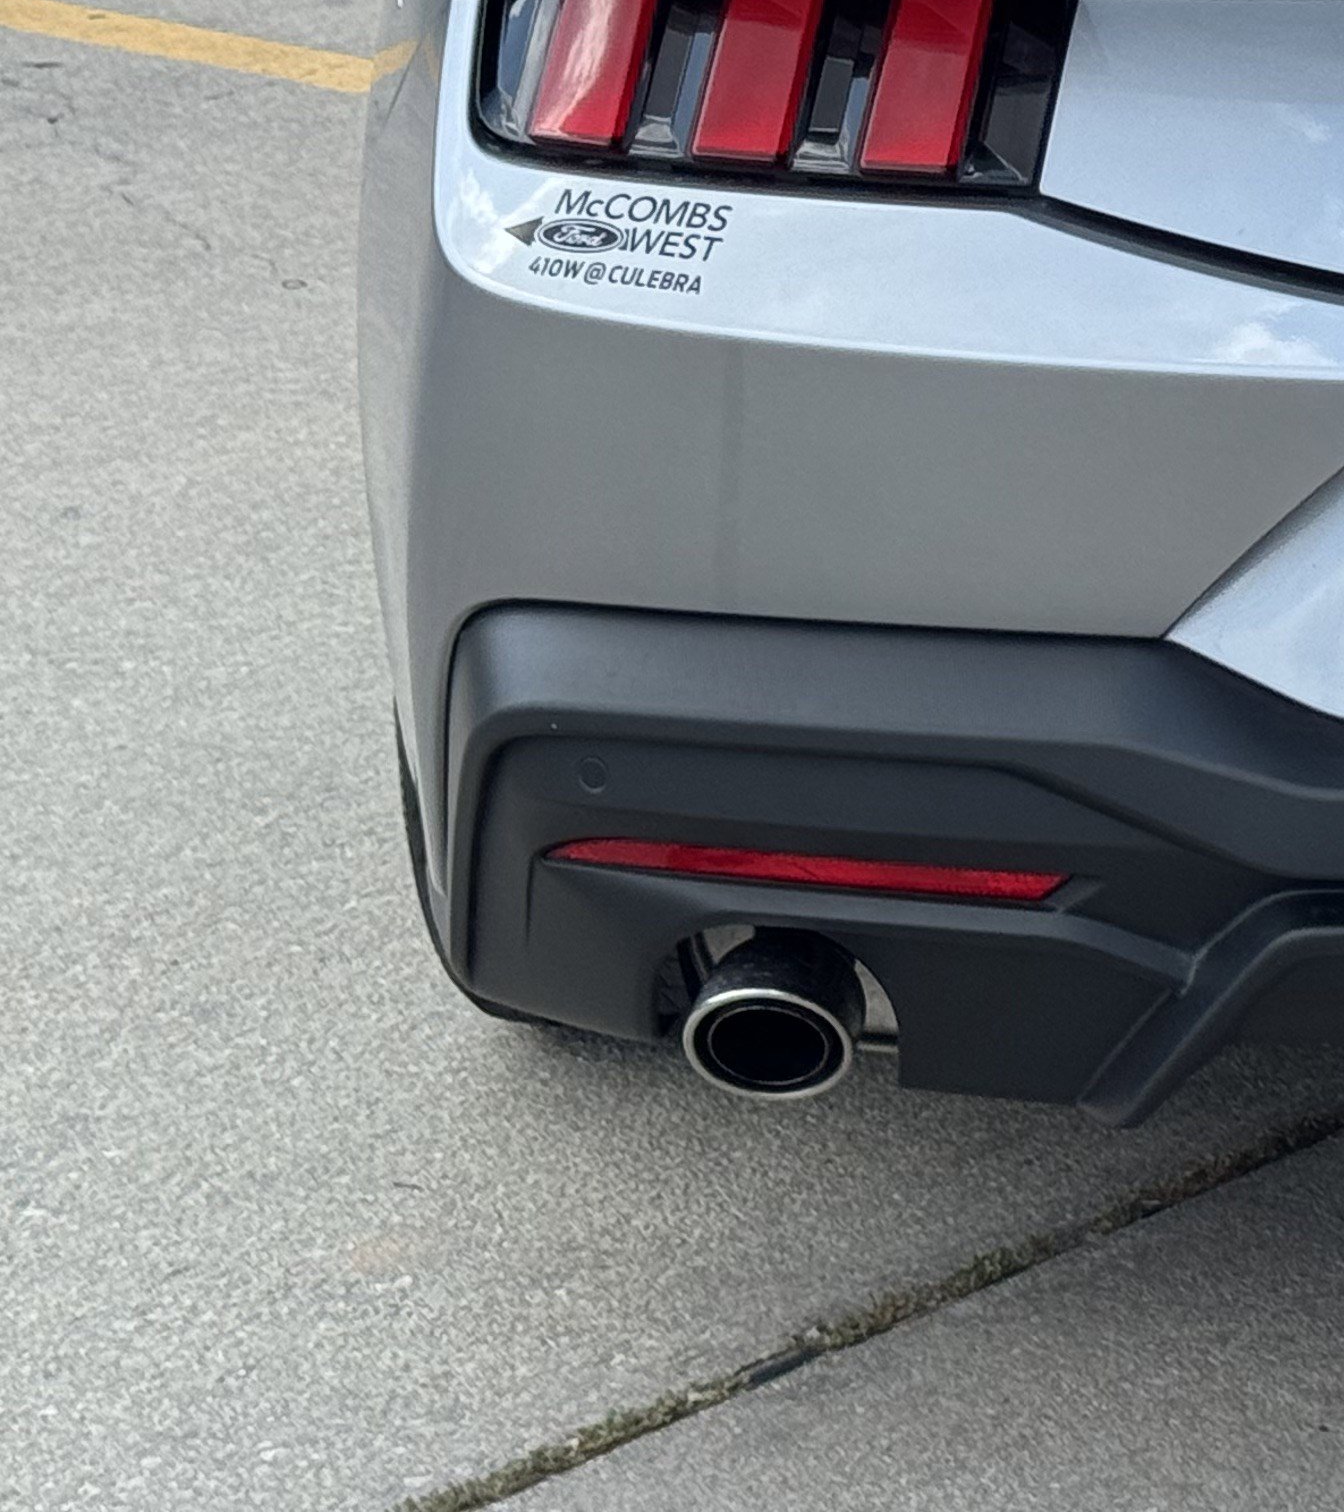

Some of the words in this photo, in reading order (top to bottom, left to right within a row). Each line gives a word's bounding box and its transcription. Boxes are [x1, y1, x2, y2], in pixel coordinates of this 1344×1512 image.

[554, 189, 733, 231] McCOMBS
[553, 224, 607, 246] Ford
[630, 227, 723, 261] WEST
